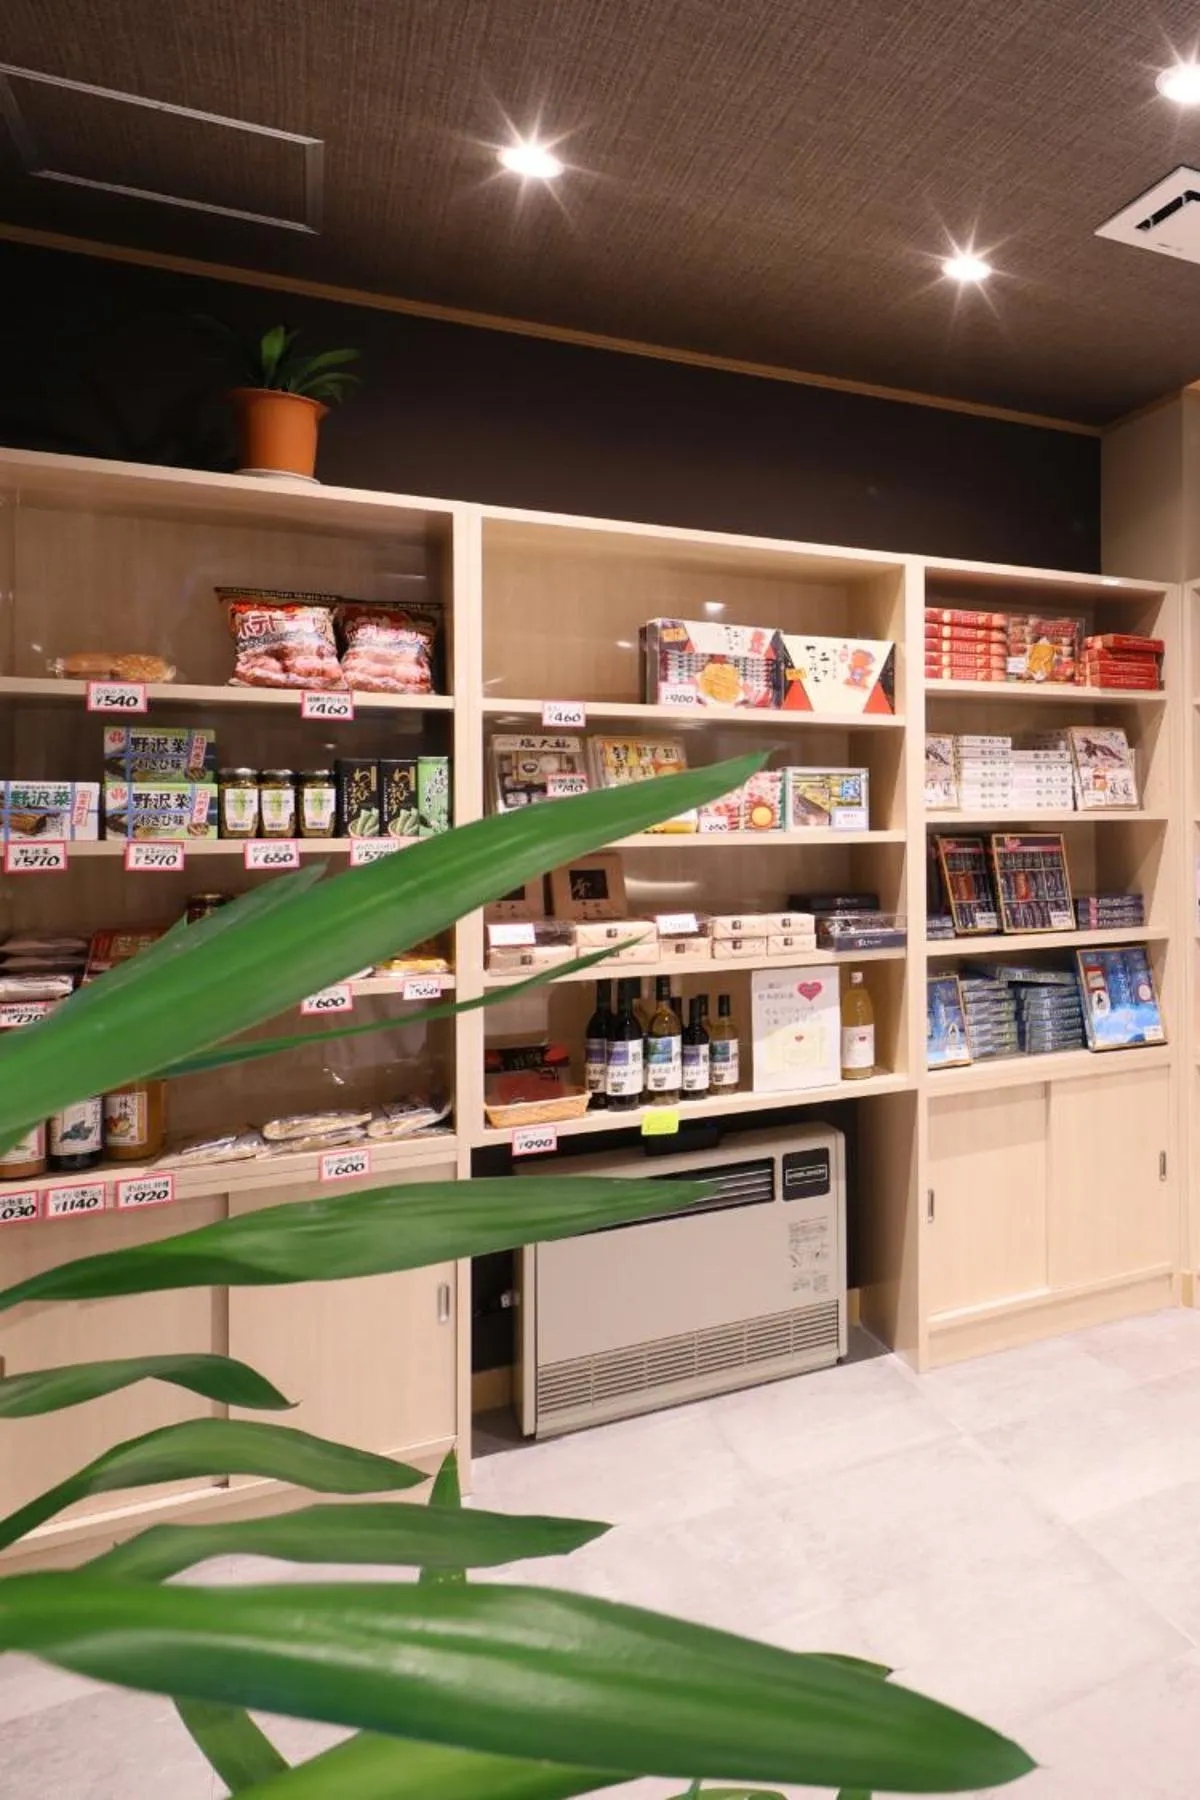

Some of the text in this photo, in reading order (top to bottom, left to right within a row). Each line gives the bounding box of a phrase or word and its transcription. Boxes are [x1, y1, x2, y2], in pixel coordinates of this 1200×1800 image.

[96, 694, 138, 707] ¥540
[131, 736, 187, 754] 野沢菜
[11, 790, 71, 806] 野沢菜
[133, 792, 192, 810] 野沢菜
[14, 854, 60, 867] ¥570
[134, 854, 177, 866] ¥570
[309, 997, 346, 1009] ¥600
[327, 1162, 365, 1176] ¥600
[124, 1189, 169, 1204] ¥920
[54, 1198, 98, 1213] ¥1140
